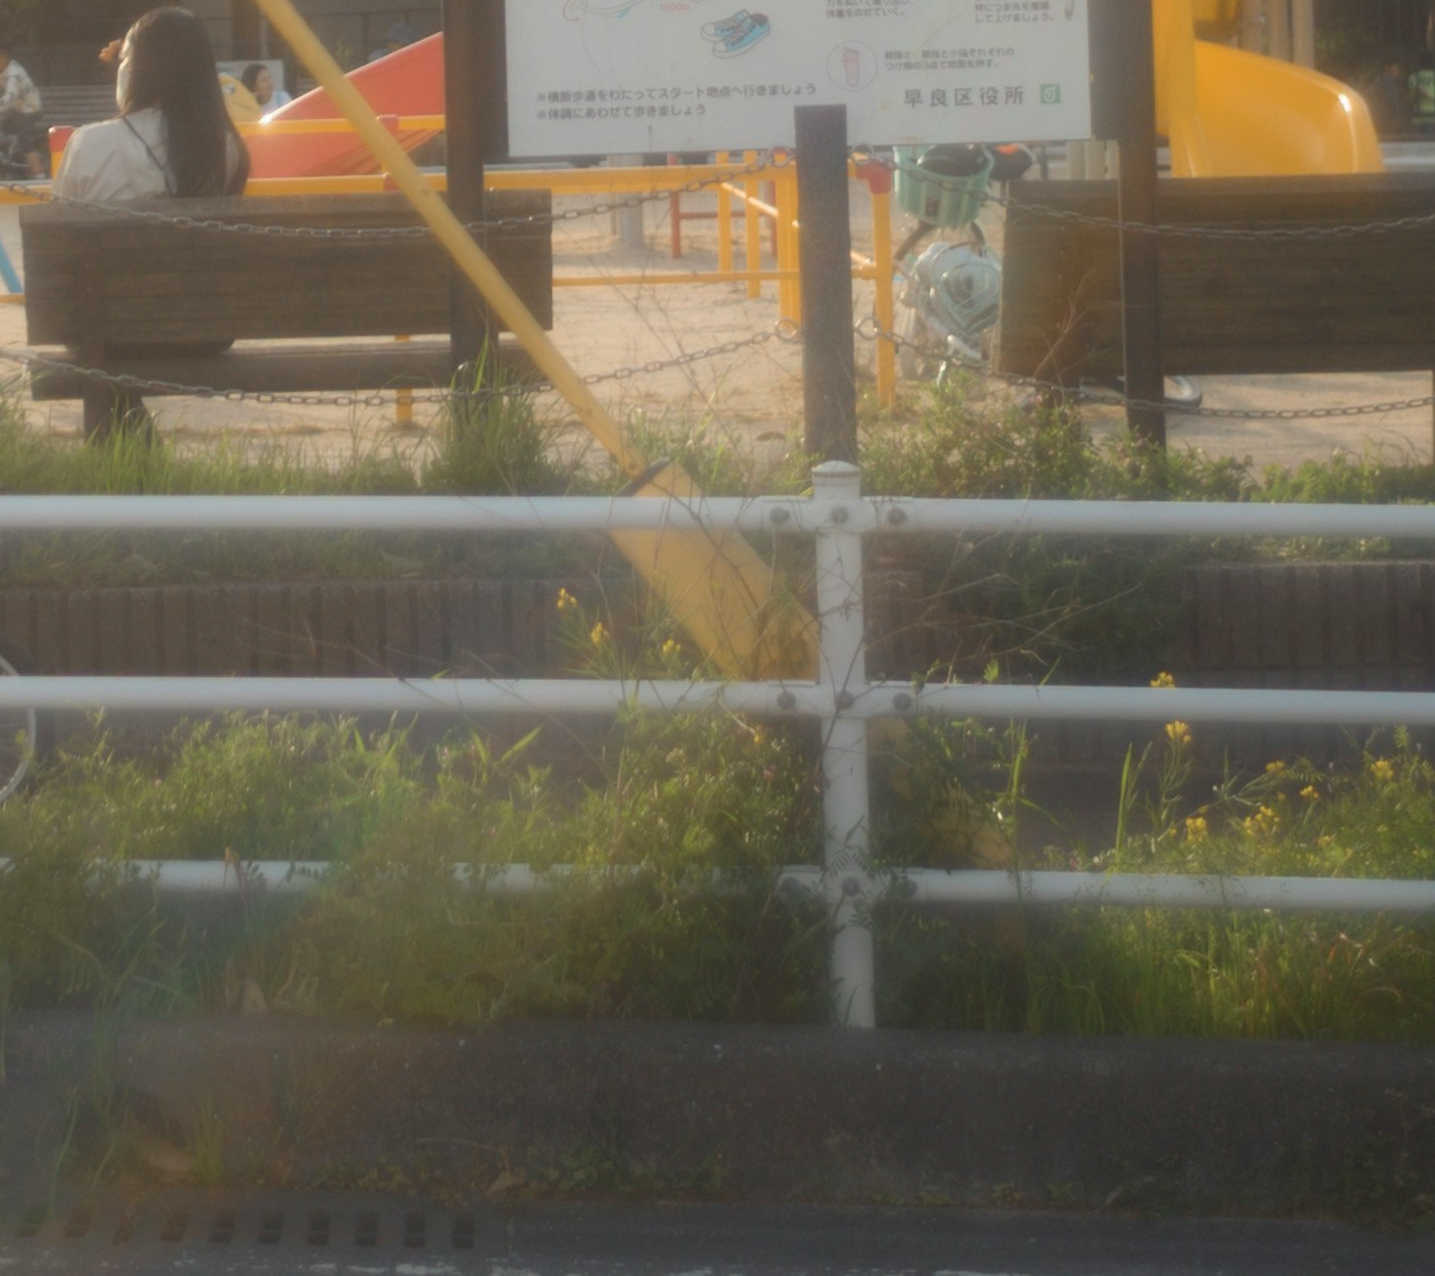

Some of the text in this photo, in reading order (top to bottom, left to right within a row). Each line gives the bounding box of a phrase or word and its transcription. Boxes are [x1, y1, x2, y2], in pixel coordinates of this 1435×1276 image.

[904, 85, 1026, 109] 早良区役所
[536, 103, 707, 121] ※体調にあわせて歩きましょう
